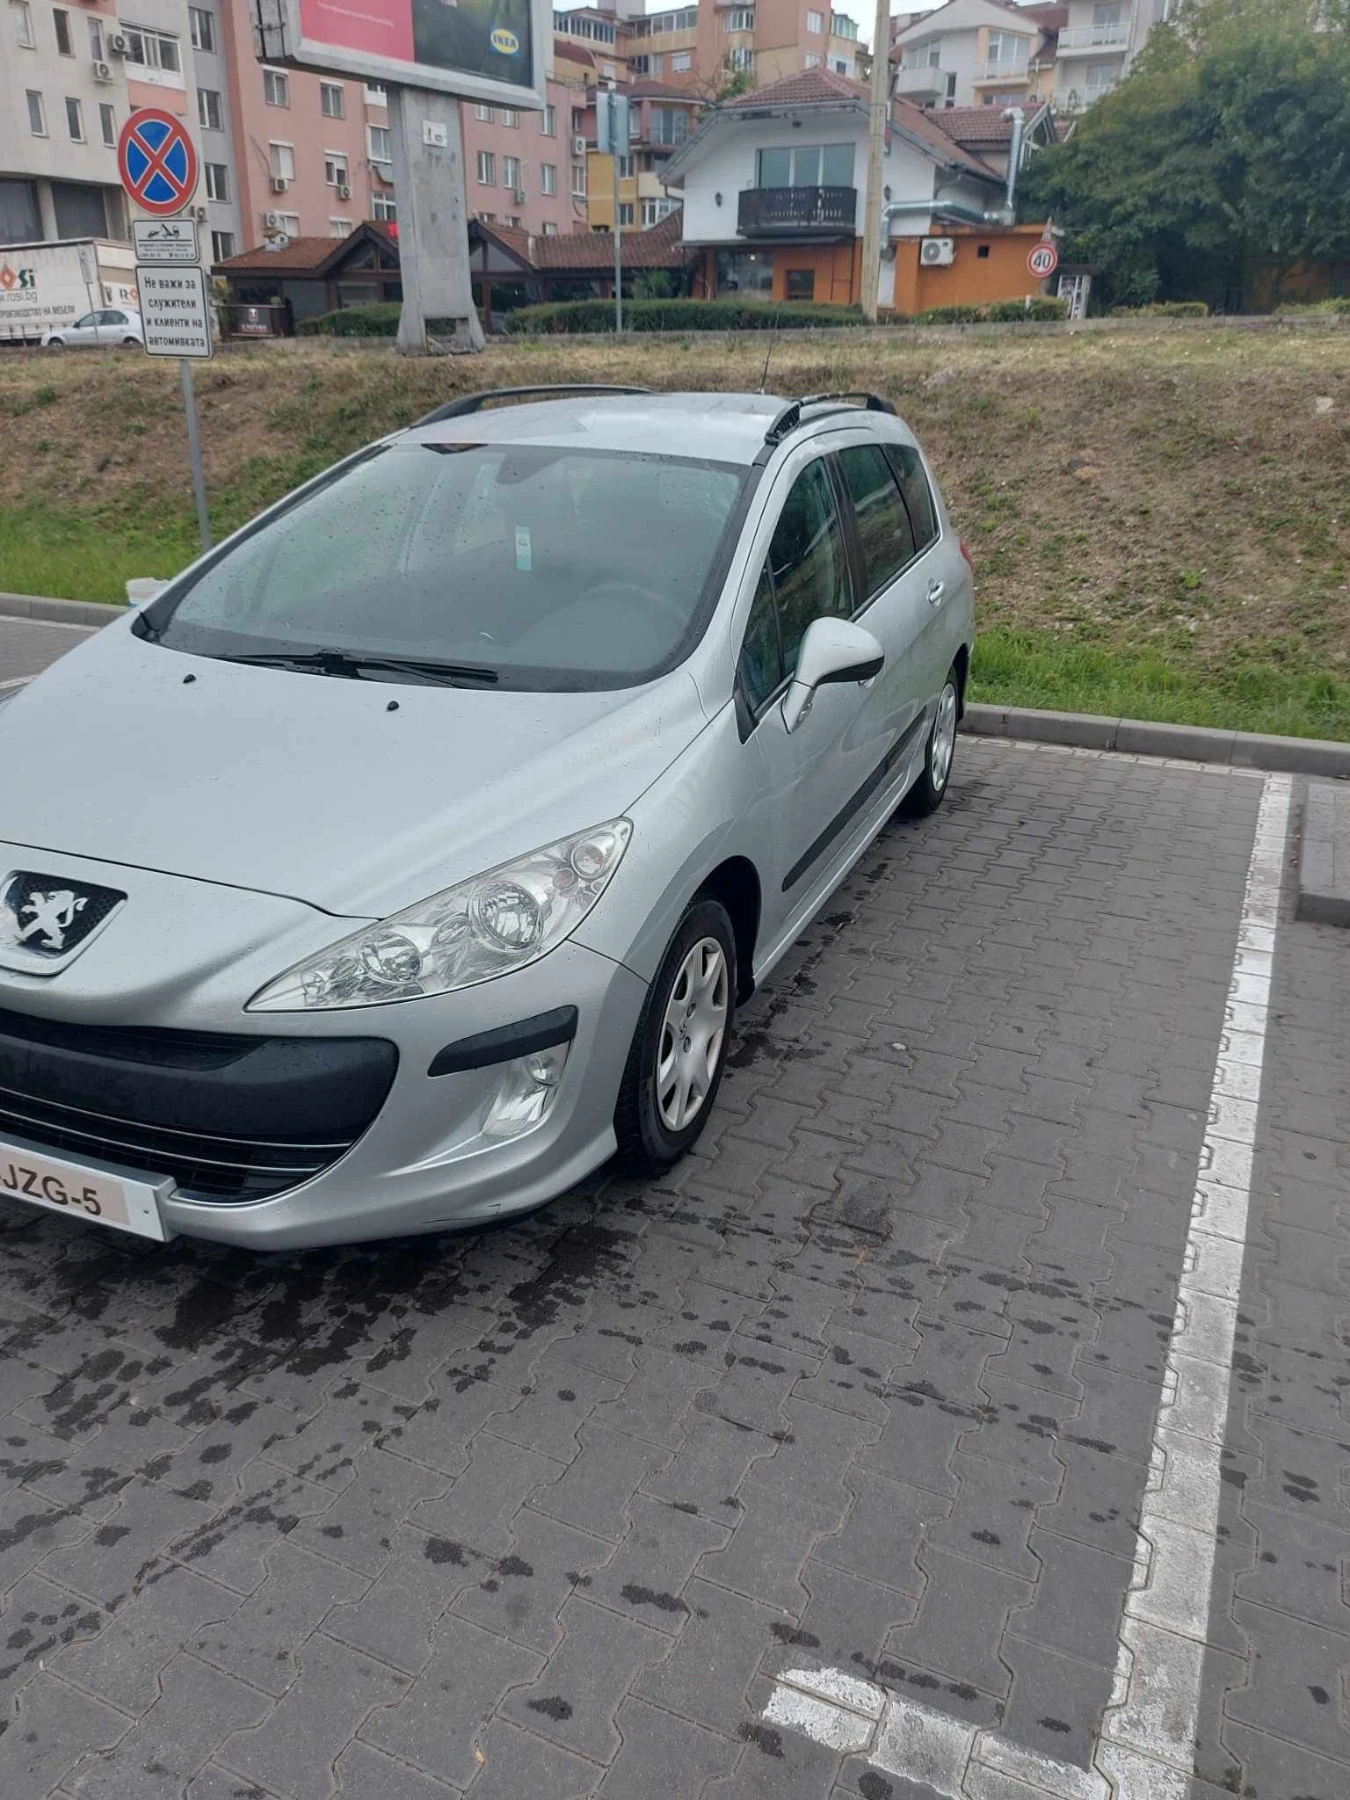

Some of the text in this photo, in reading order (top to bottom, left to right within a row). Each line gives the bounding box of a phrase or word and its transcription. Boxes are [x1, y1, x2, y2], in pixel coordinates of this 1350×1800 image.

[491, 33, 518, 50] IKEA
[1033, 253, 1052, 269] 40
[143, 276, 196, 289] Не важи за
[148, 298, 197, 311] служители
[146, 317, 203, 328] и клиенти на
[148, 336, 206, 348] автомивката
[0, 1164, 102, 1216] JZG-5
